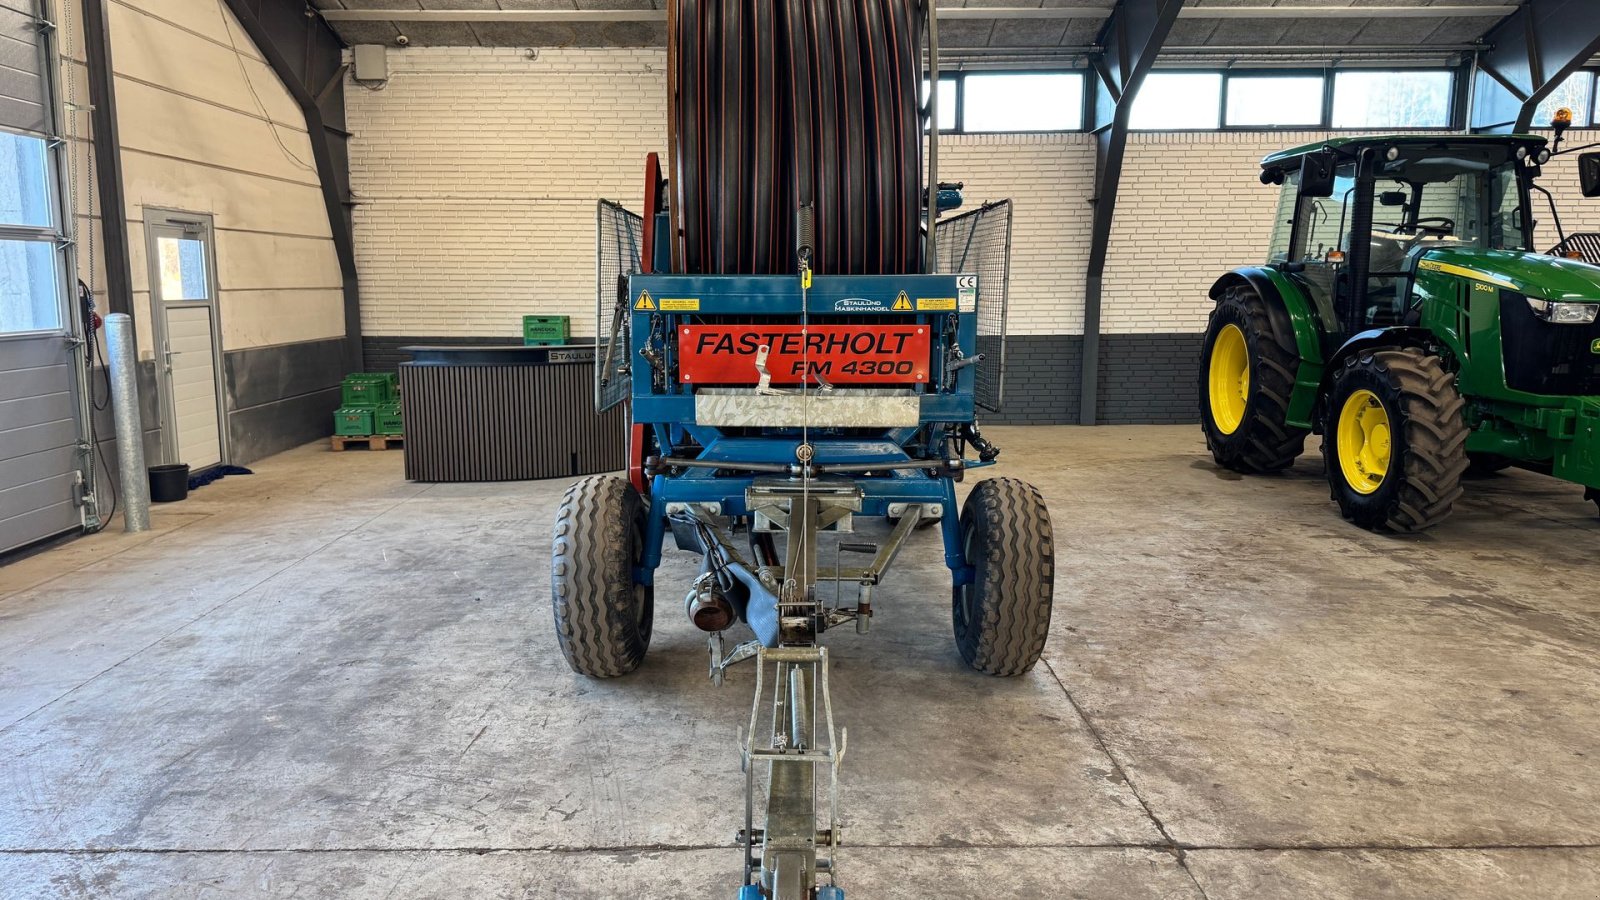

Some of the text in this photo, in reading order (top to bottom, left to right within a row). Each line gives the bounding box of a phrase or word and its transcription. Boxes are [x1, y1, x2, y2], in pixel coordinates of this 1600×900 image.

[959, 276, 974, 288] CE
[695, 333, 914, 355] FASTERHOLT
[791, 361, 914, 376] FM 4300
